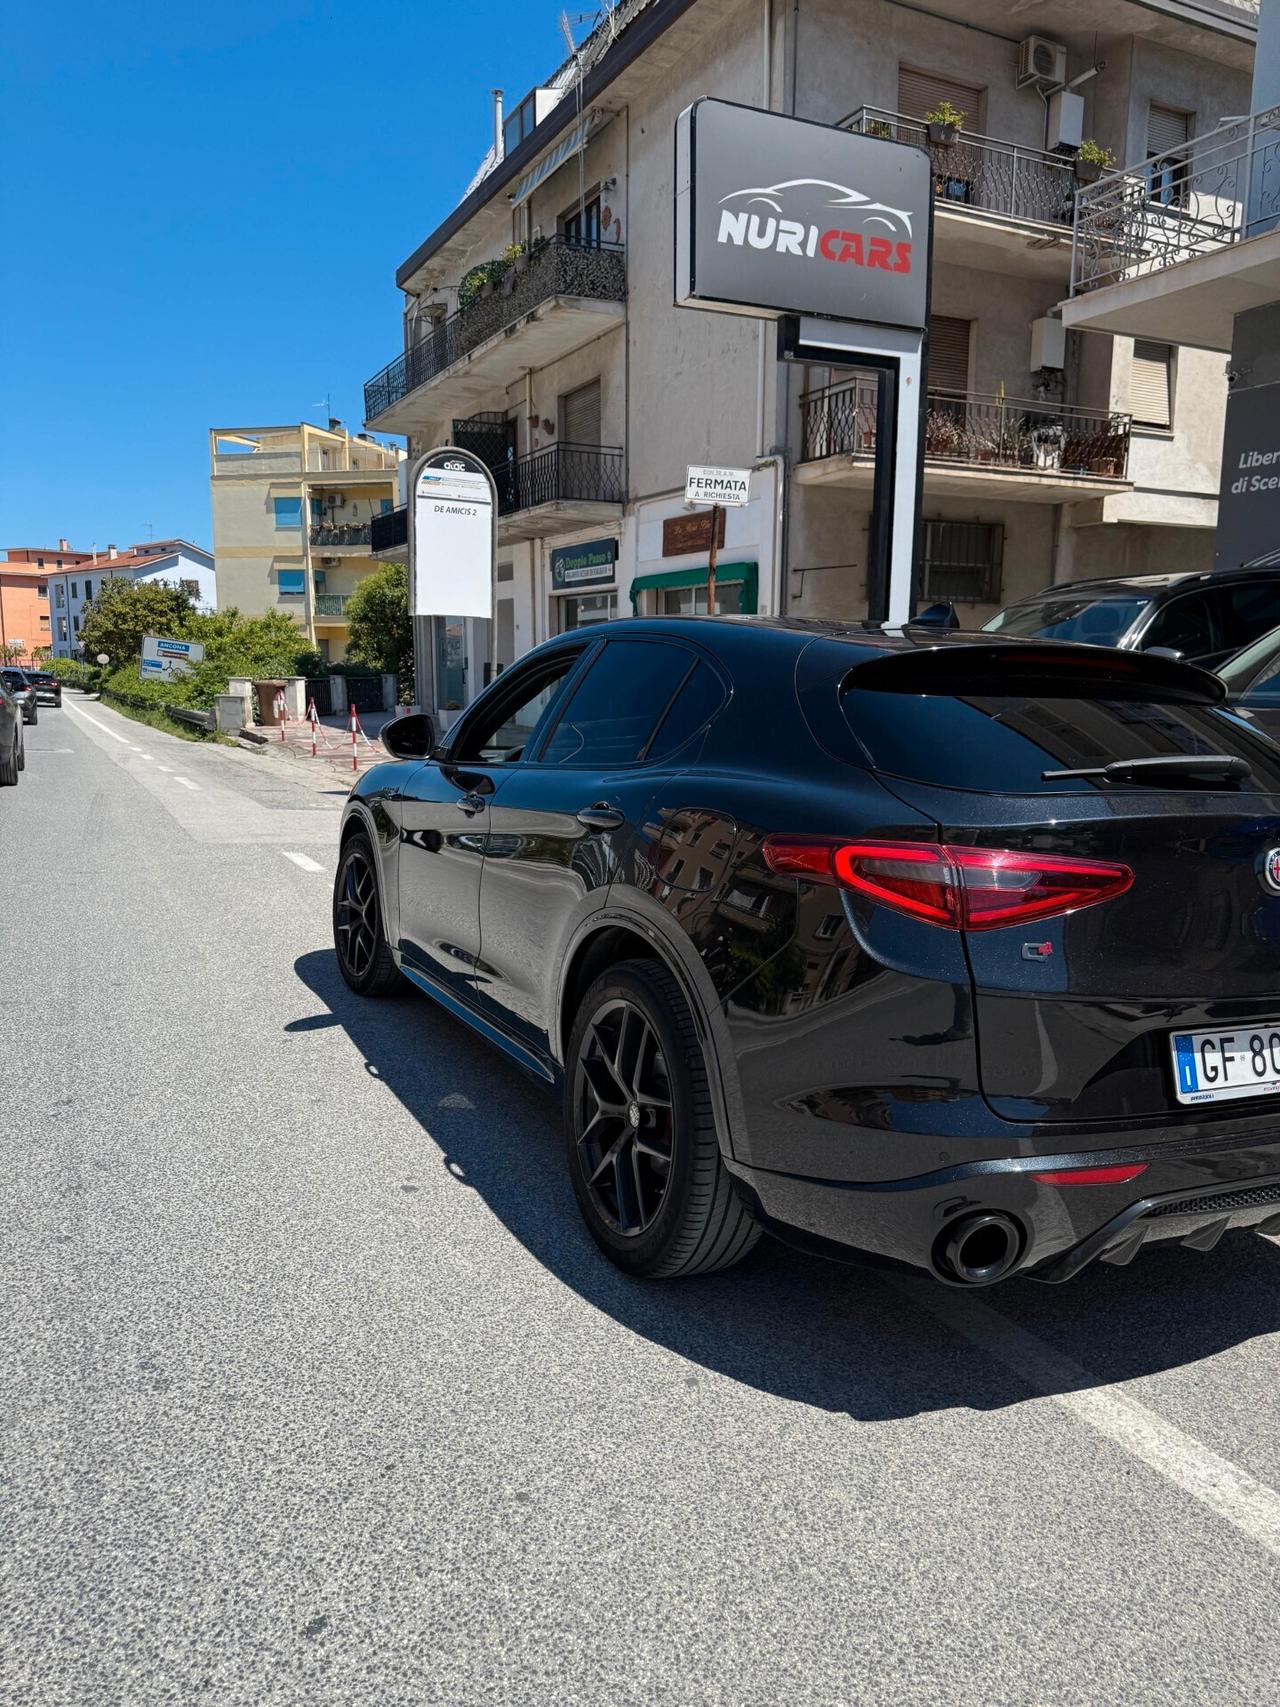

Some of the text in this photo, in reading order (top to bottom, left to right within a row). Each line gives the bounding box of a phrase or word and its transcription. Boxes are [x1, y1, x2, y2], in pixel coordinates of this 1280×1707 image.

[1238, 451, 1280, 469] Liber
[689, 476, 747, 491] FERMATA
[1231, 476, 1249, 494] di
[703, 491, 740, 500] RICHIESTA
[433, 505, 477, 516] DE AMICIS 2
[159, 642, 186, 650] ANCONA
[1200, 1037, 1236, 1083] GF
